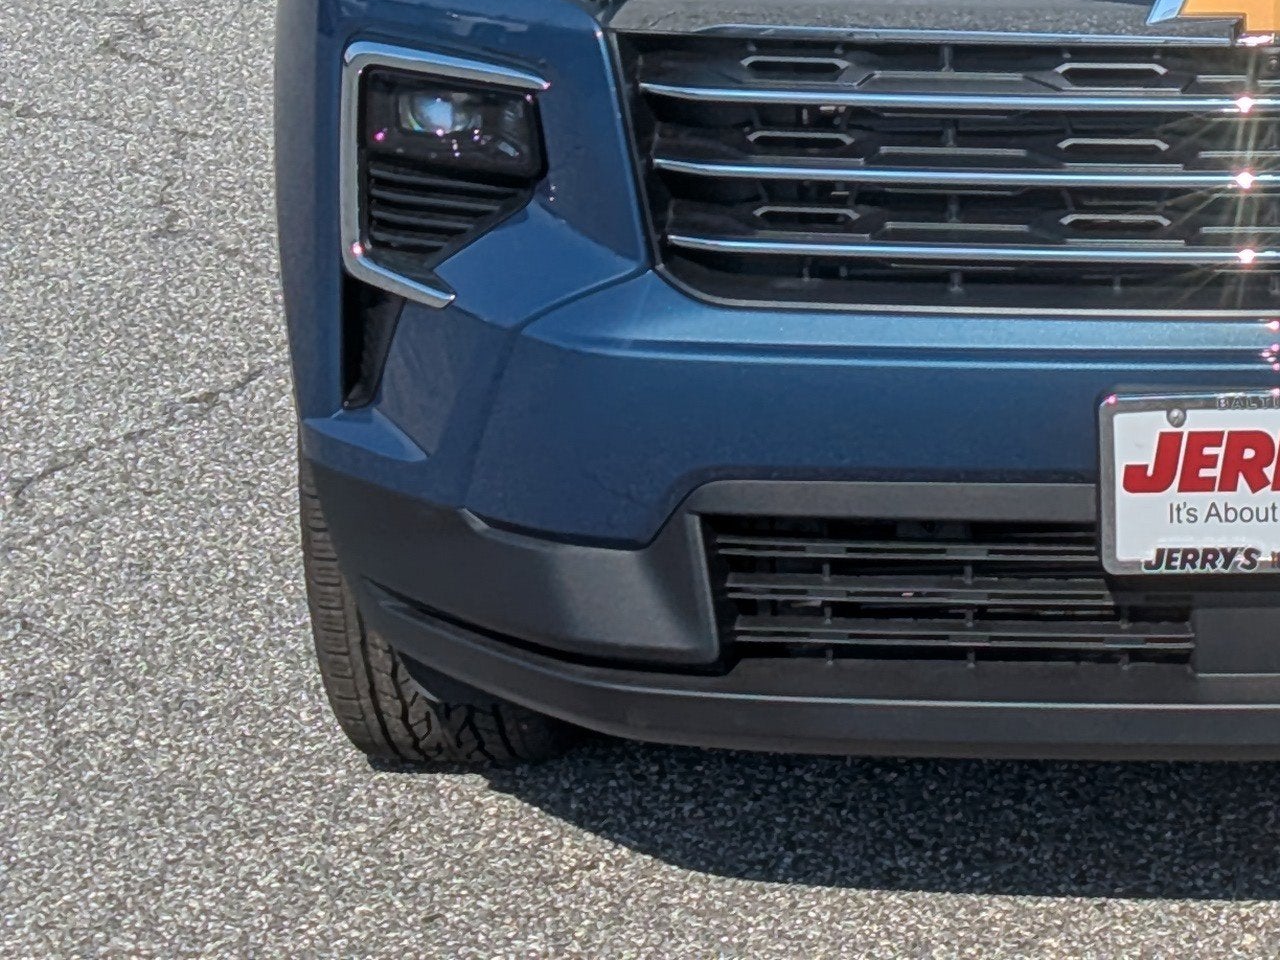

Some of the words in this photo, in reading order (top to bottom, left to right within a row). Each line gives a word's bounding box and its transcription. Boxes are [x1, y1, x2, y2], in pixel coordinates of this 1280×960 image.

[1169, 502, 1198, 524] It's
[1204, 501, 1279, 524] About
[1143, 547, 1262, 572] JERRY'S
